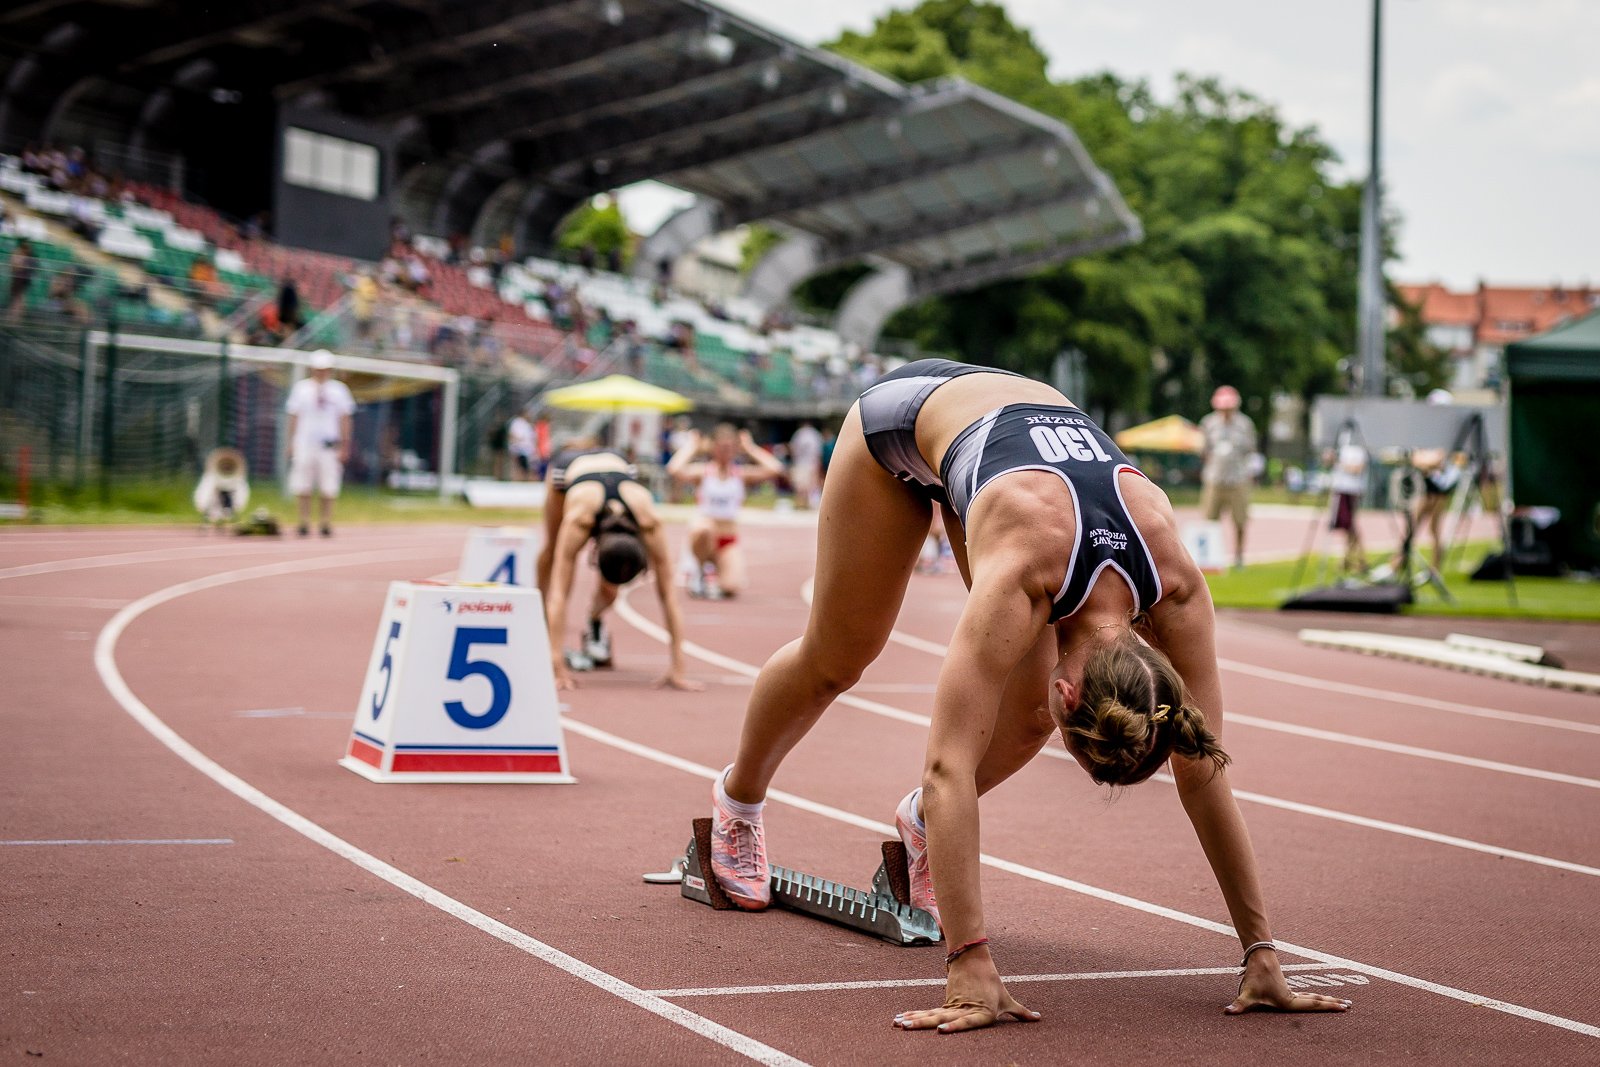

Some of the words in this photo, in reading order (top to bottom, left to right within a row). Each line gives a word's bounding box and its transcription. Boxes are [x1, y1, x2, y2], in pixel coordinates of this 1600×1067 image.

[1028, 425, 1113, 463] 130
[486, 550, 518, 585] 4
[371, 620, 402, 722] 5
[443, 625, 513, 731] 5
